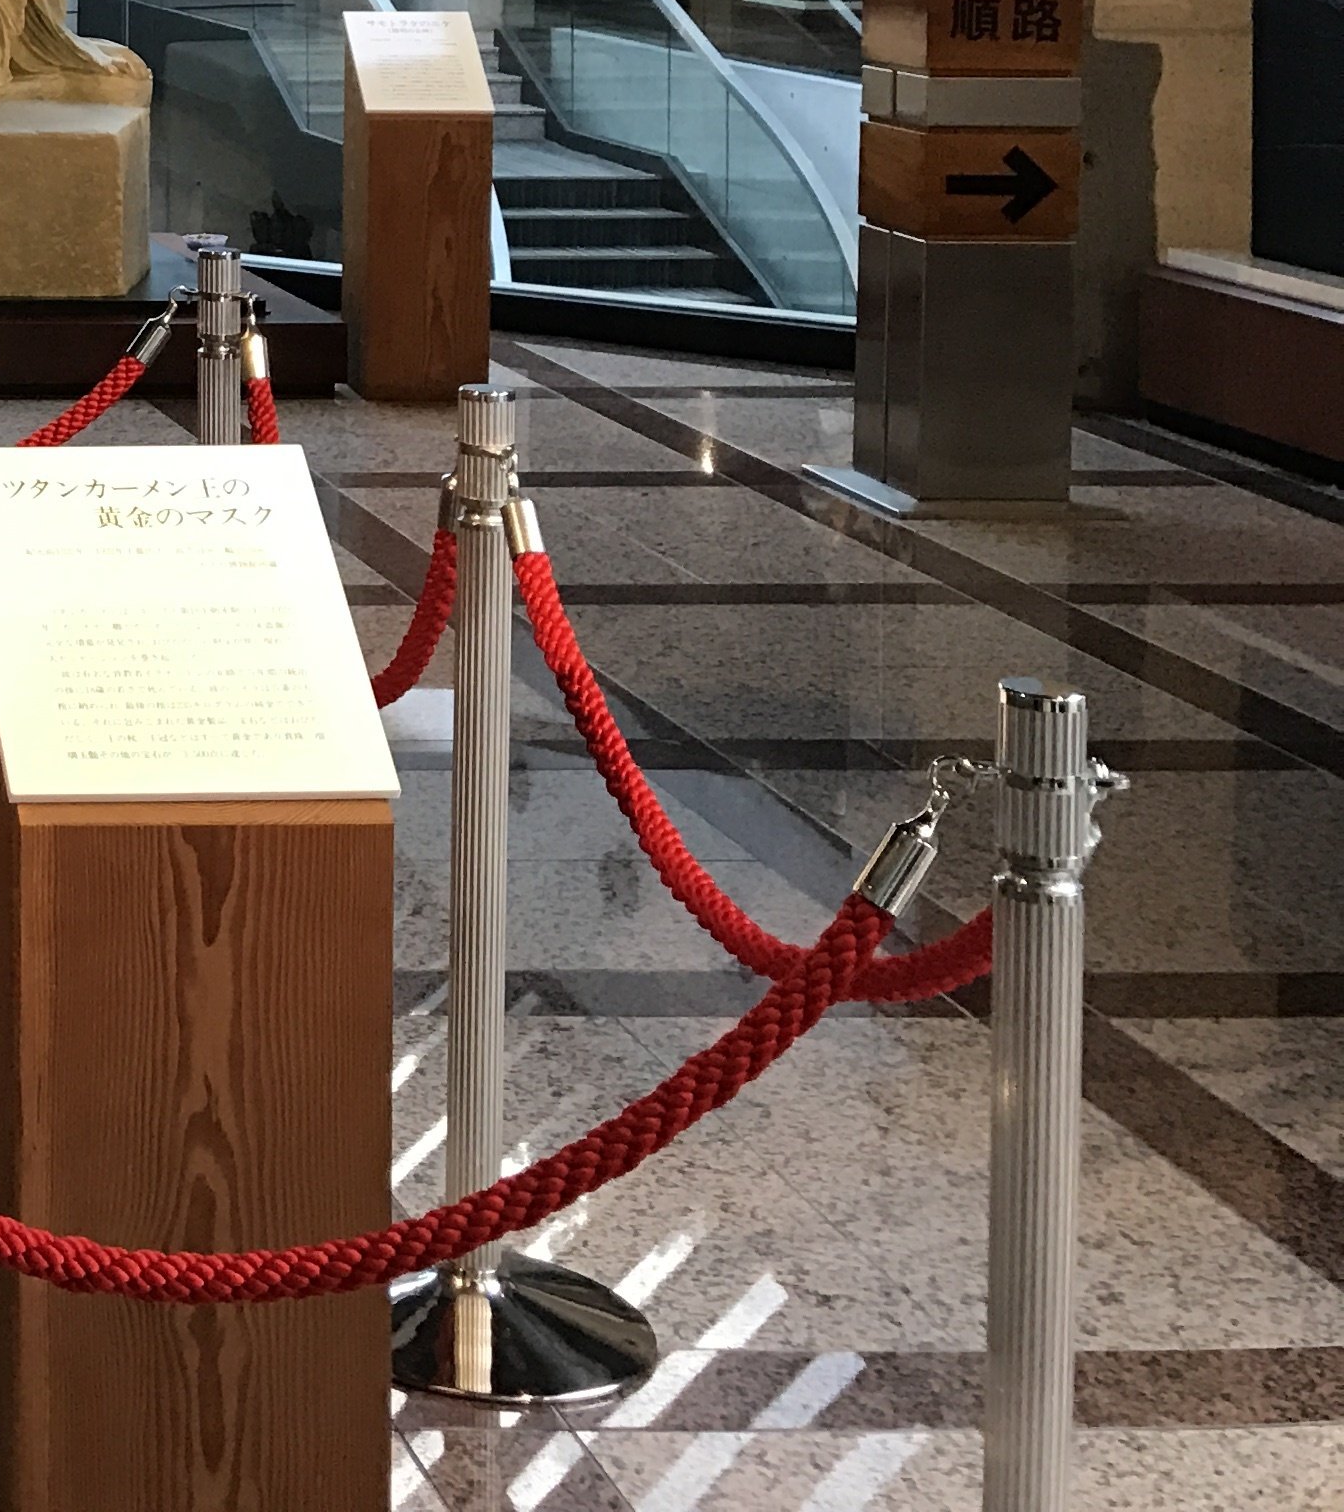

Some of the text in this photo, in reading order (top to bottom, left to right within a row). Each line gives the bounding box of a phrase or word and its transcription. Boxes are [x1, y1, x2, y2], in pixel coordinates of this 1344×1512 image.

[2, 478, 250, 499] ツタンカーメン王の
[95, 505, 273, 529] 黄金のマスク
